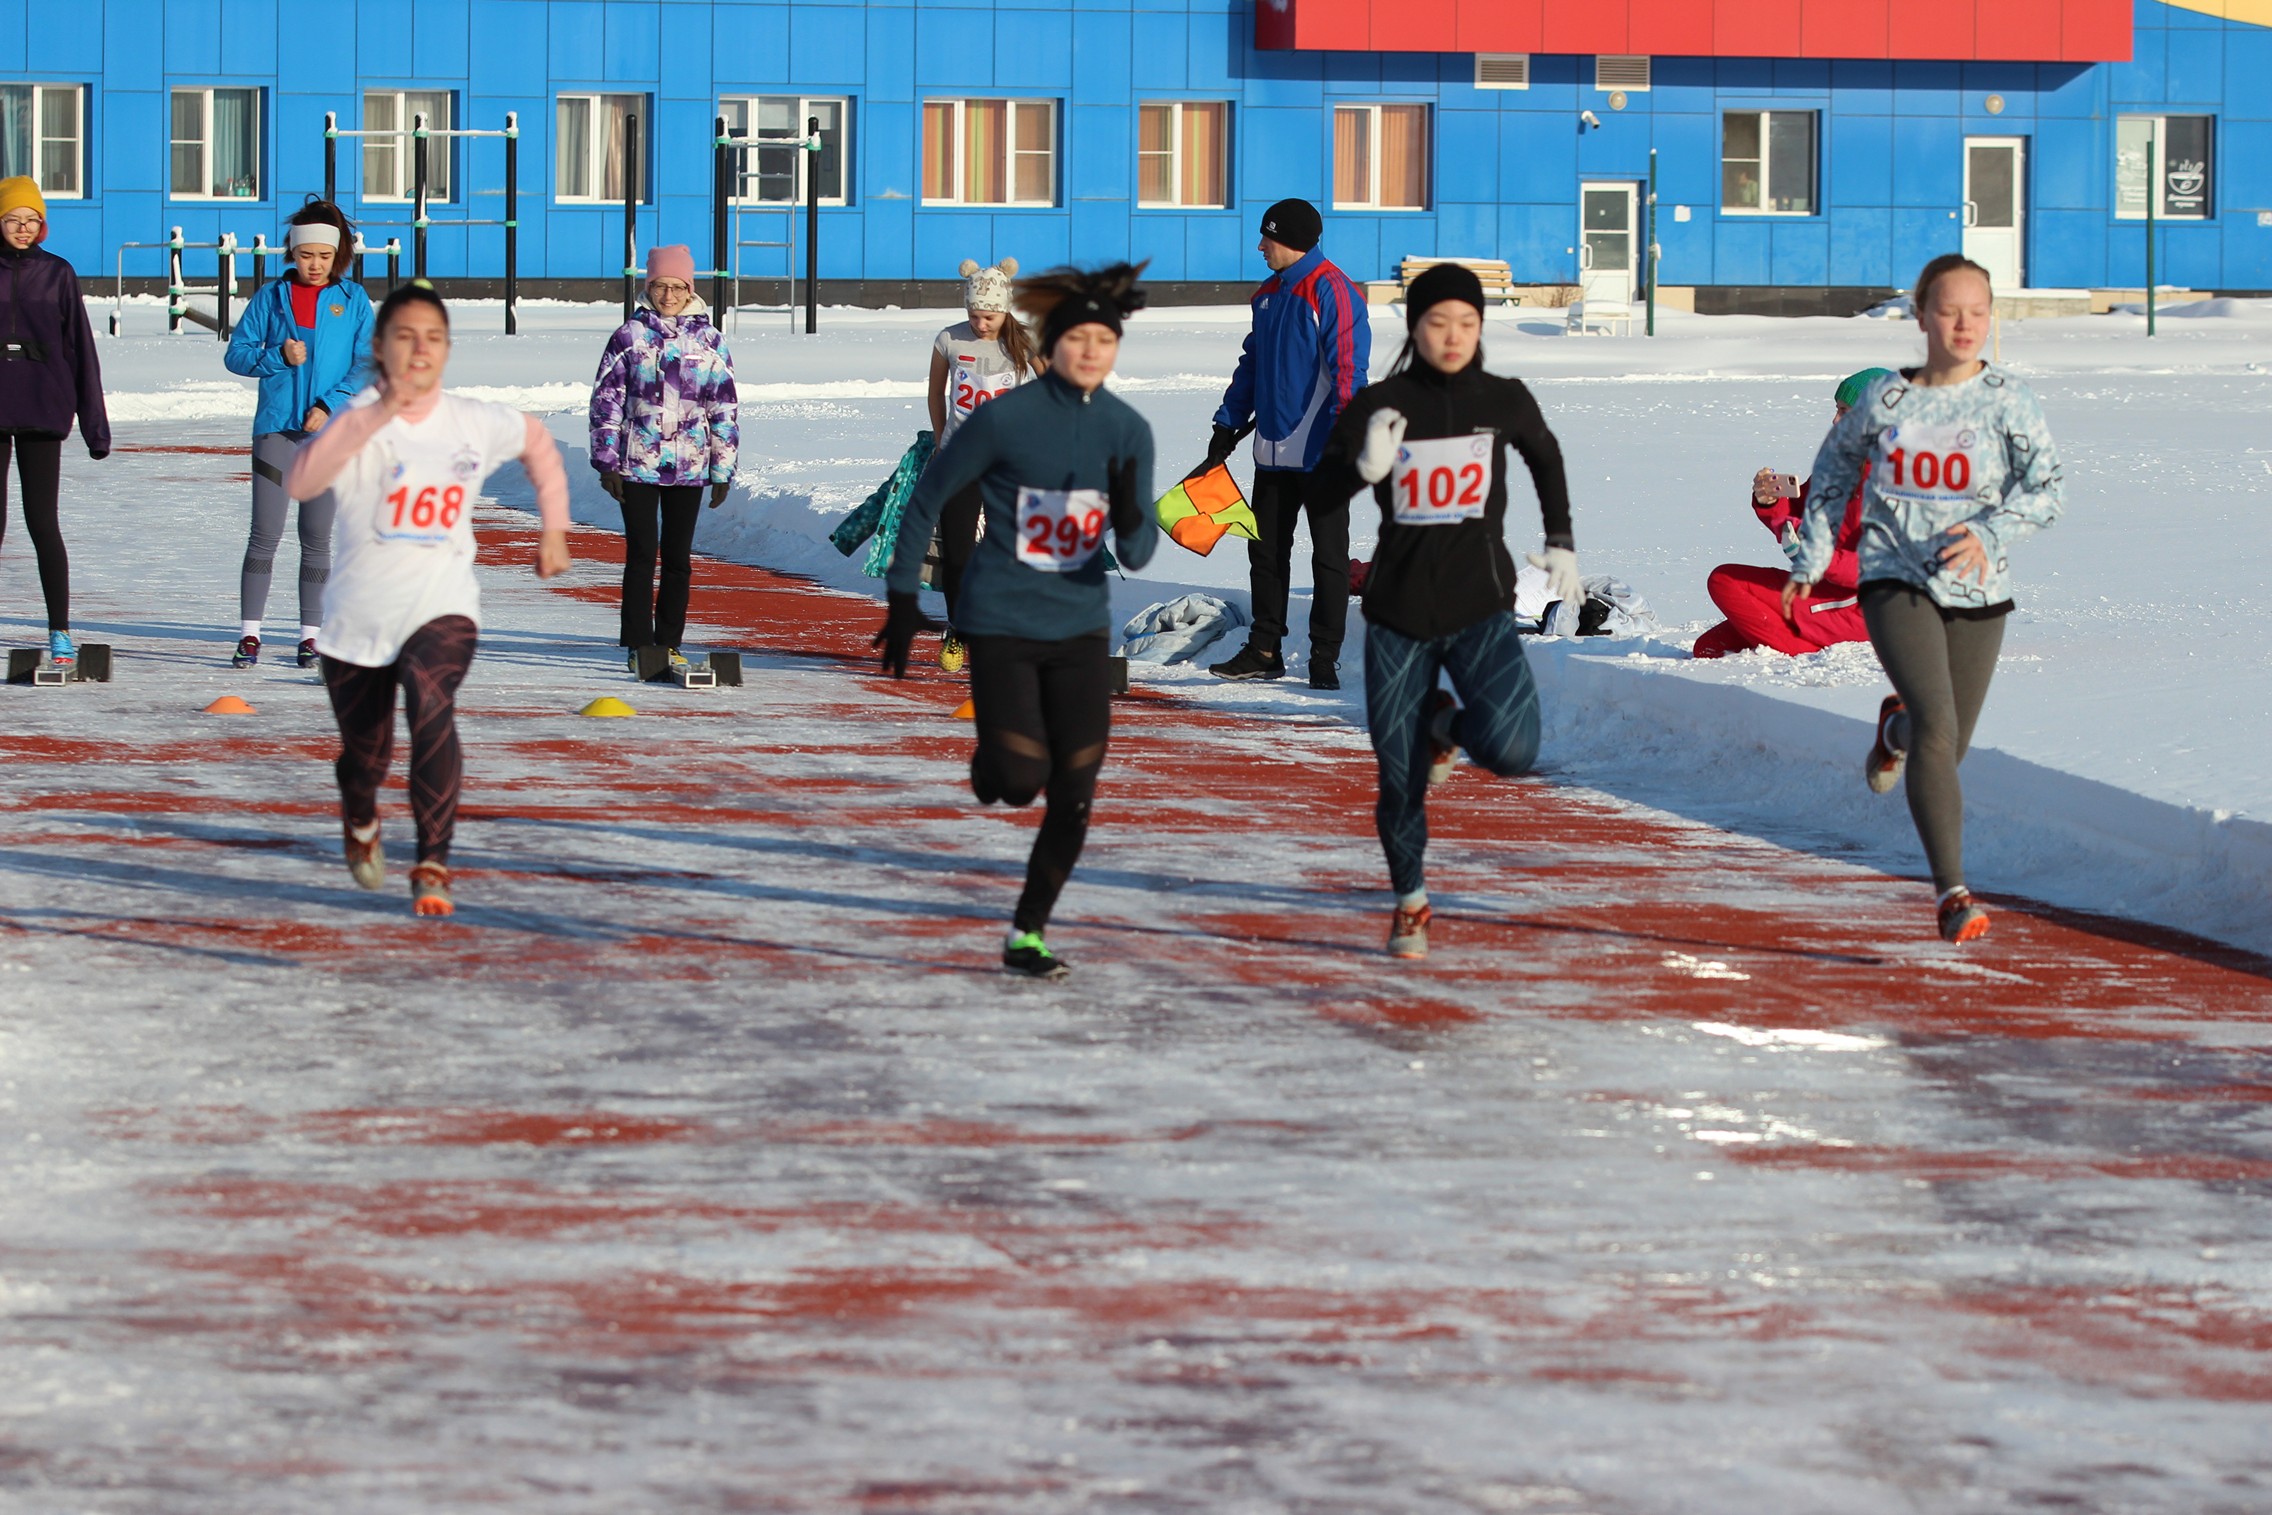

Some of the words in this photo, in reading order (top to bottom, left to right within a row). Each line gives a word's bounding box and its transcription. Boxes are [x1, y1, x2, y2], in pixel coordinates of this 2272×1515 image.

[956, 384, 1011, 410] 20
[1399, 463, 1484, 509] 102
[1887, 447, 1970, 491] 100
[387, 485, 465, 529] 168
[1025, 509, 1105, 558] 299
